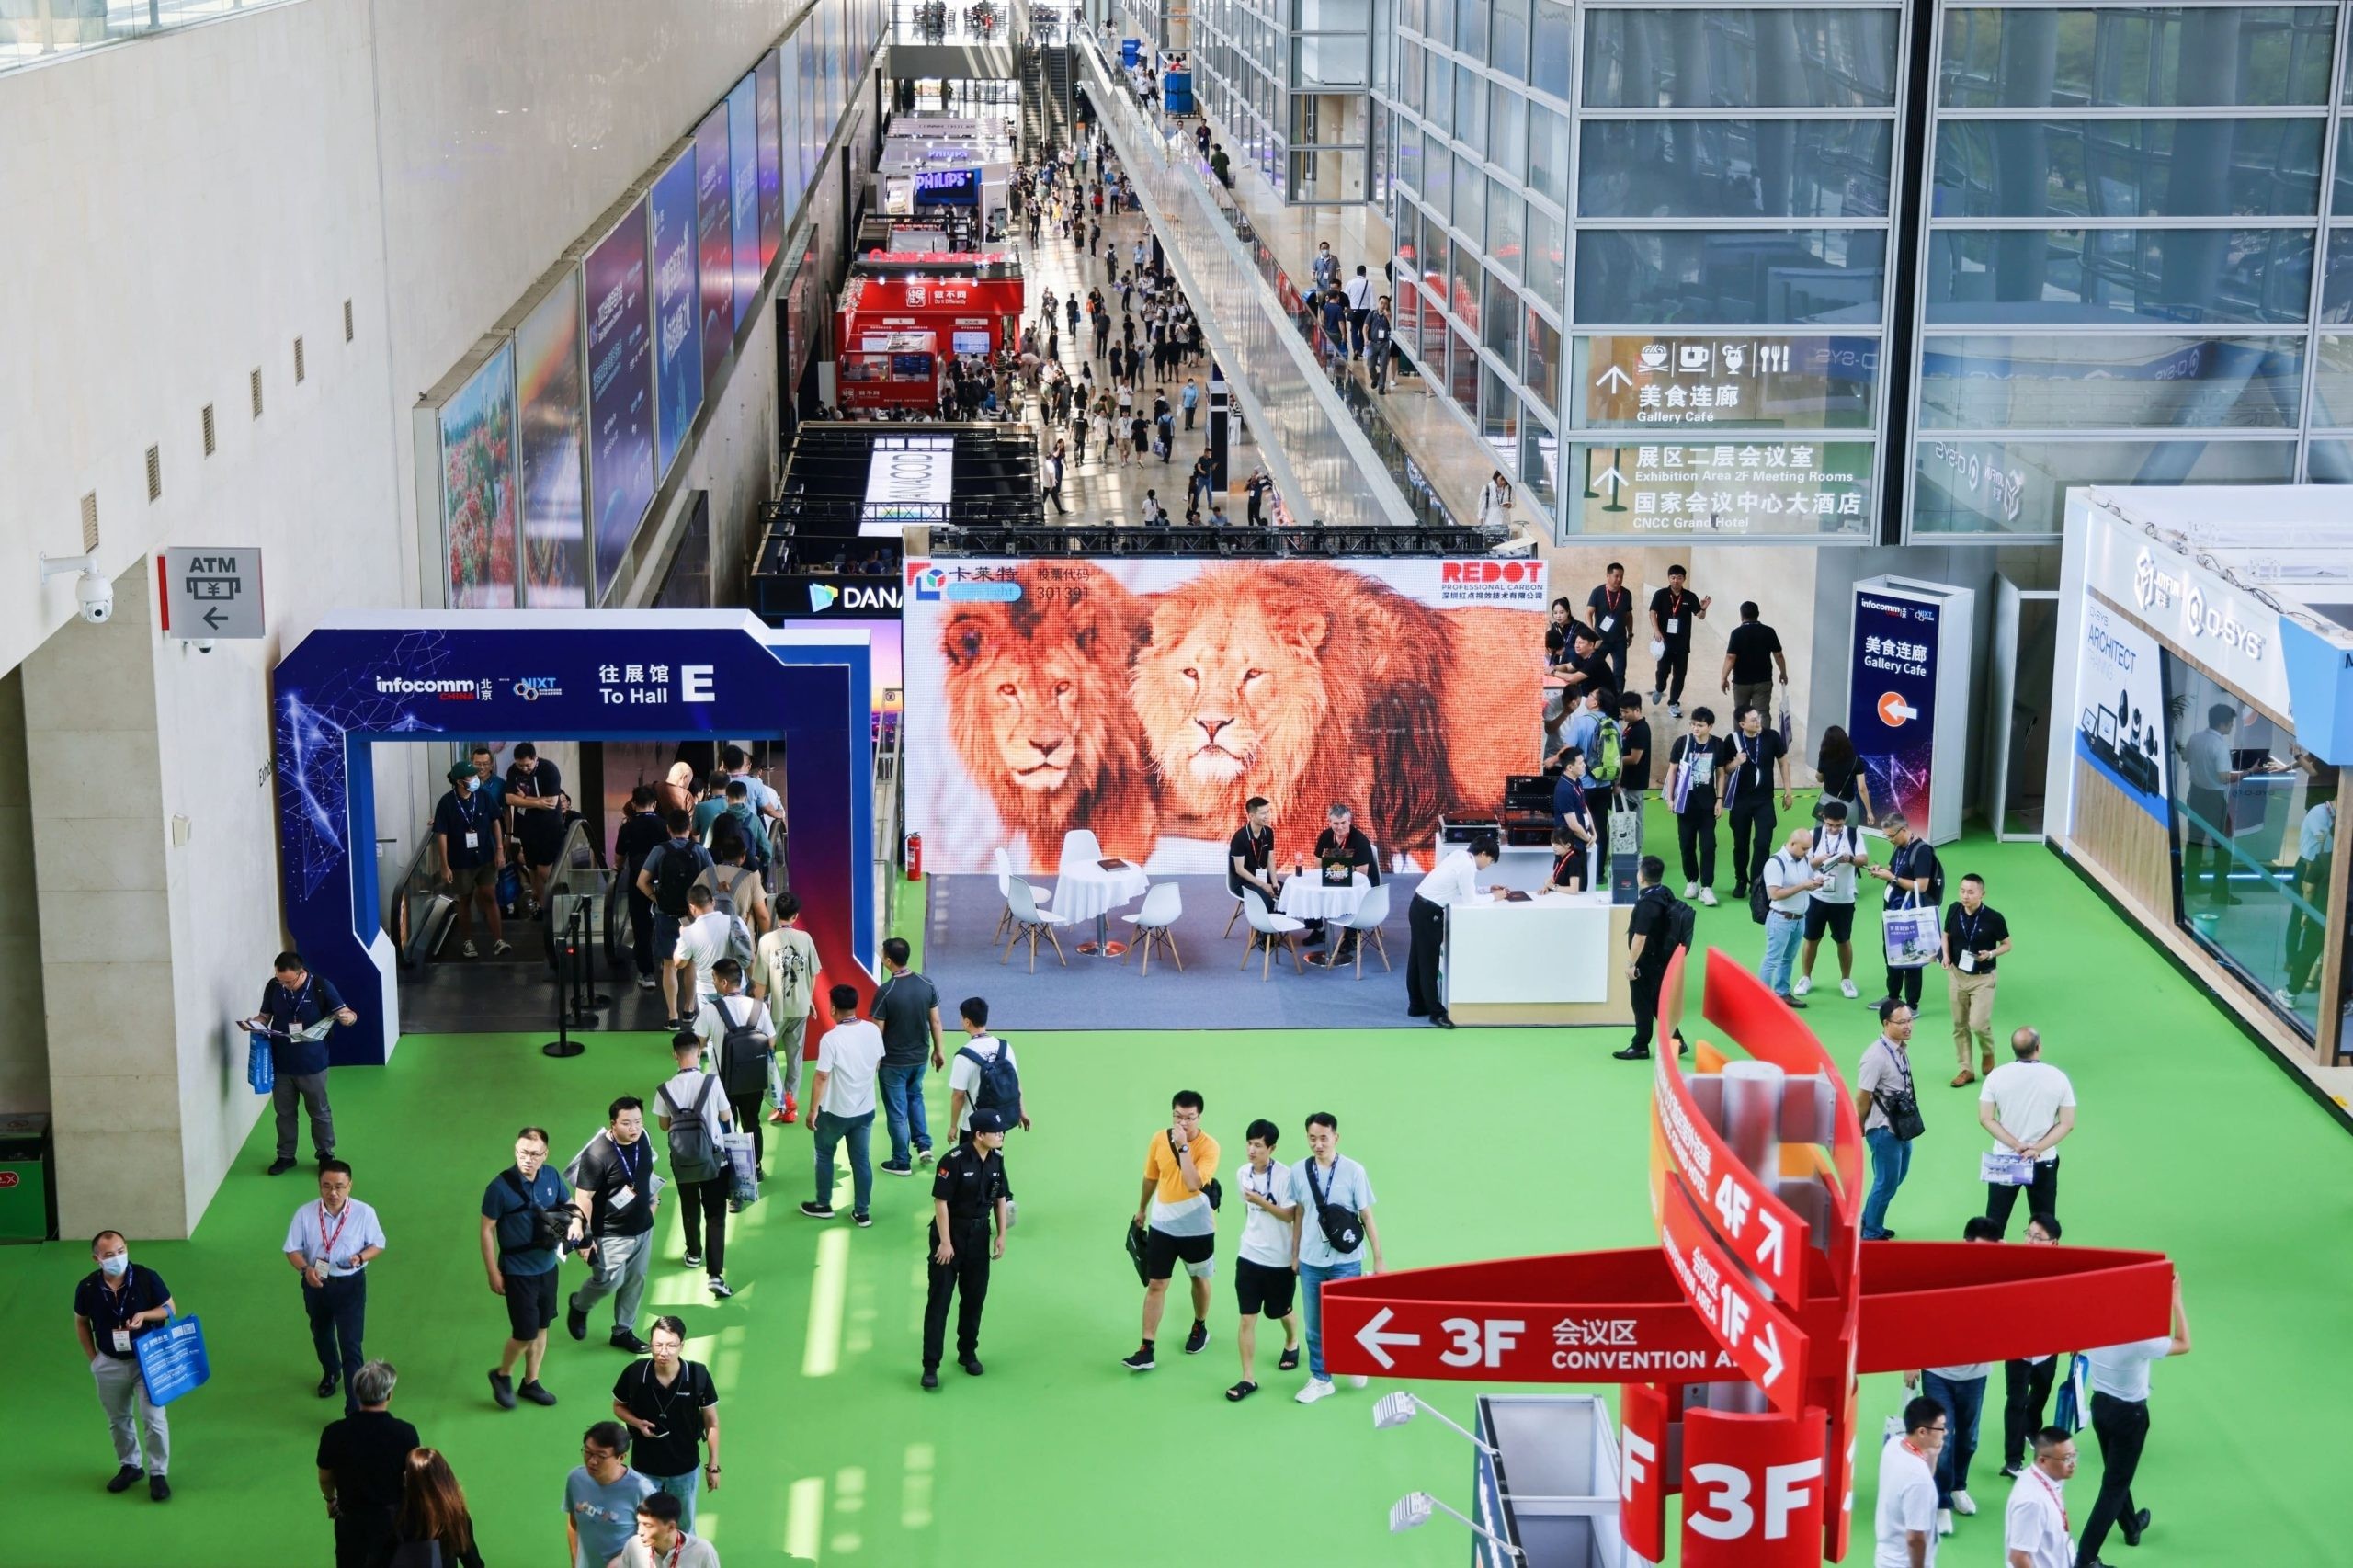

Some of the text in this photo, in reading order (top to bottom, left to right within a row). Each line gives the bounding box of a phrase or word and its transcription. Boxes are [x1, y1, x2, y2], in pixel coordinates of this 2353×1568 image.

[915, 172, 965, 189] PHILIPS
[1639, 385, 1739, 408] 美食连廊
[1637, 412, 1714, 424] Gallery Café
[1636, 446, 1813, 468] 展区二层会议室
[1635, 471, 1853, 483] Exhibition Area 2F Meeting Rooms
[1633, 491, 1861, 515] 国家会议中心大酒店
[1633, 517, 1749, 528] CNCC Grand Hotel
[189, 557, 236, 573] ATM
[949, 566, 1018, 582] 卡莱特
[1037, 567, 1090, 582] 股票代码
[1442, 562, 1543, 583] REDOT
[1037, 586, 1089, 600] 301391
[1861, 598, 1901, 612] infocomm
[2207, 608, 2261, 660] Q-SYS
[1865, 635, 1927, 664] 美食连廊
[2088, 624, 2136, 675] ARCHITECT
[599, 664, 669, 684] 往展馆
[1864, 655, 1927, 677] Gallery Cafe
[376, 675, 474, 693] infocomm
[481, 678, 493, 701] 北京
[521, 677, 557, 688] NIXT
[599, 665, 716, 704] To Hall E
[1715, 1174, 1751, 1239] 4F
[1695, 1286, 1717, 1325] AREA
[1721, 1284, 1750, 1348] 1F
[1439, 1317, 1525, 1368] 3F
[1552, 1318, 1638, 1346] 会议区
[1552, 1351, 1740, 1369] CONVENTION A
[1688, 1457, 1822, 1540] 3F
